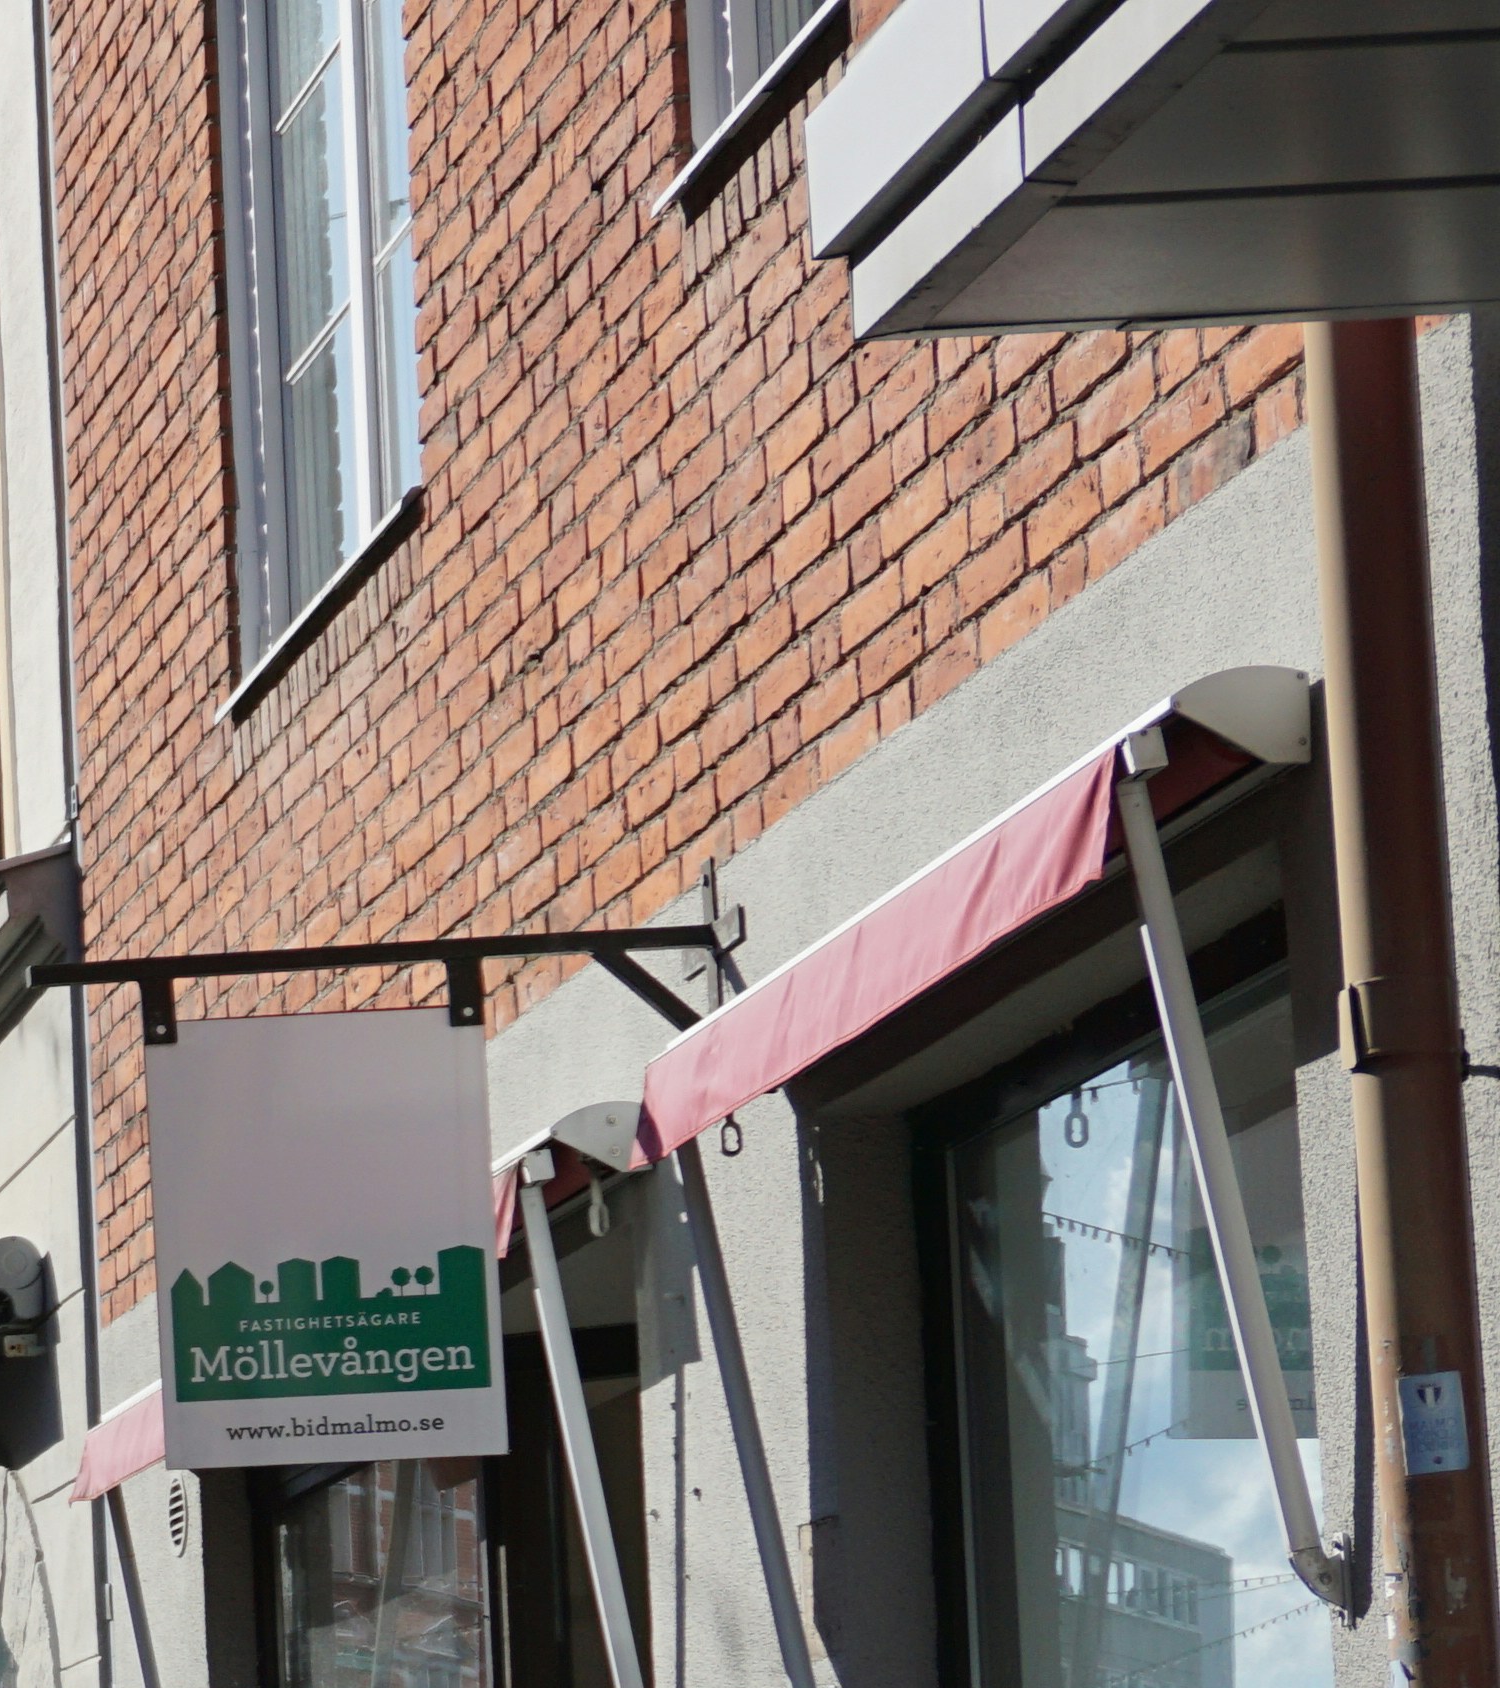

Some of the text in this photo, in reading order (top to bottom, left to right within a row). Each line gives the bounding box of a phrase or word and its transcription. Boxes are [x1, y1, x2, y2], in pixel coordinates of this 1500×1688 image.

[240, 1312, 422, 1332] FASTIGHETSÄGARE
[190, 1336, 475, 1383] Möllevången
[226, 1414, 445, 1440] www.bidmalmo.se
